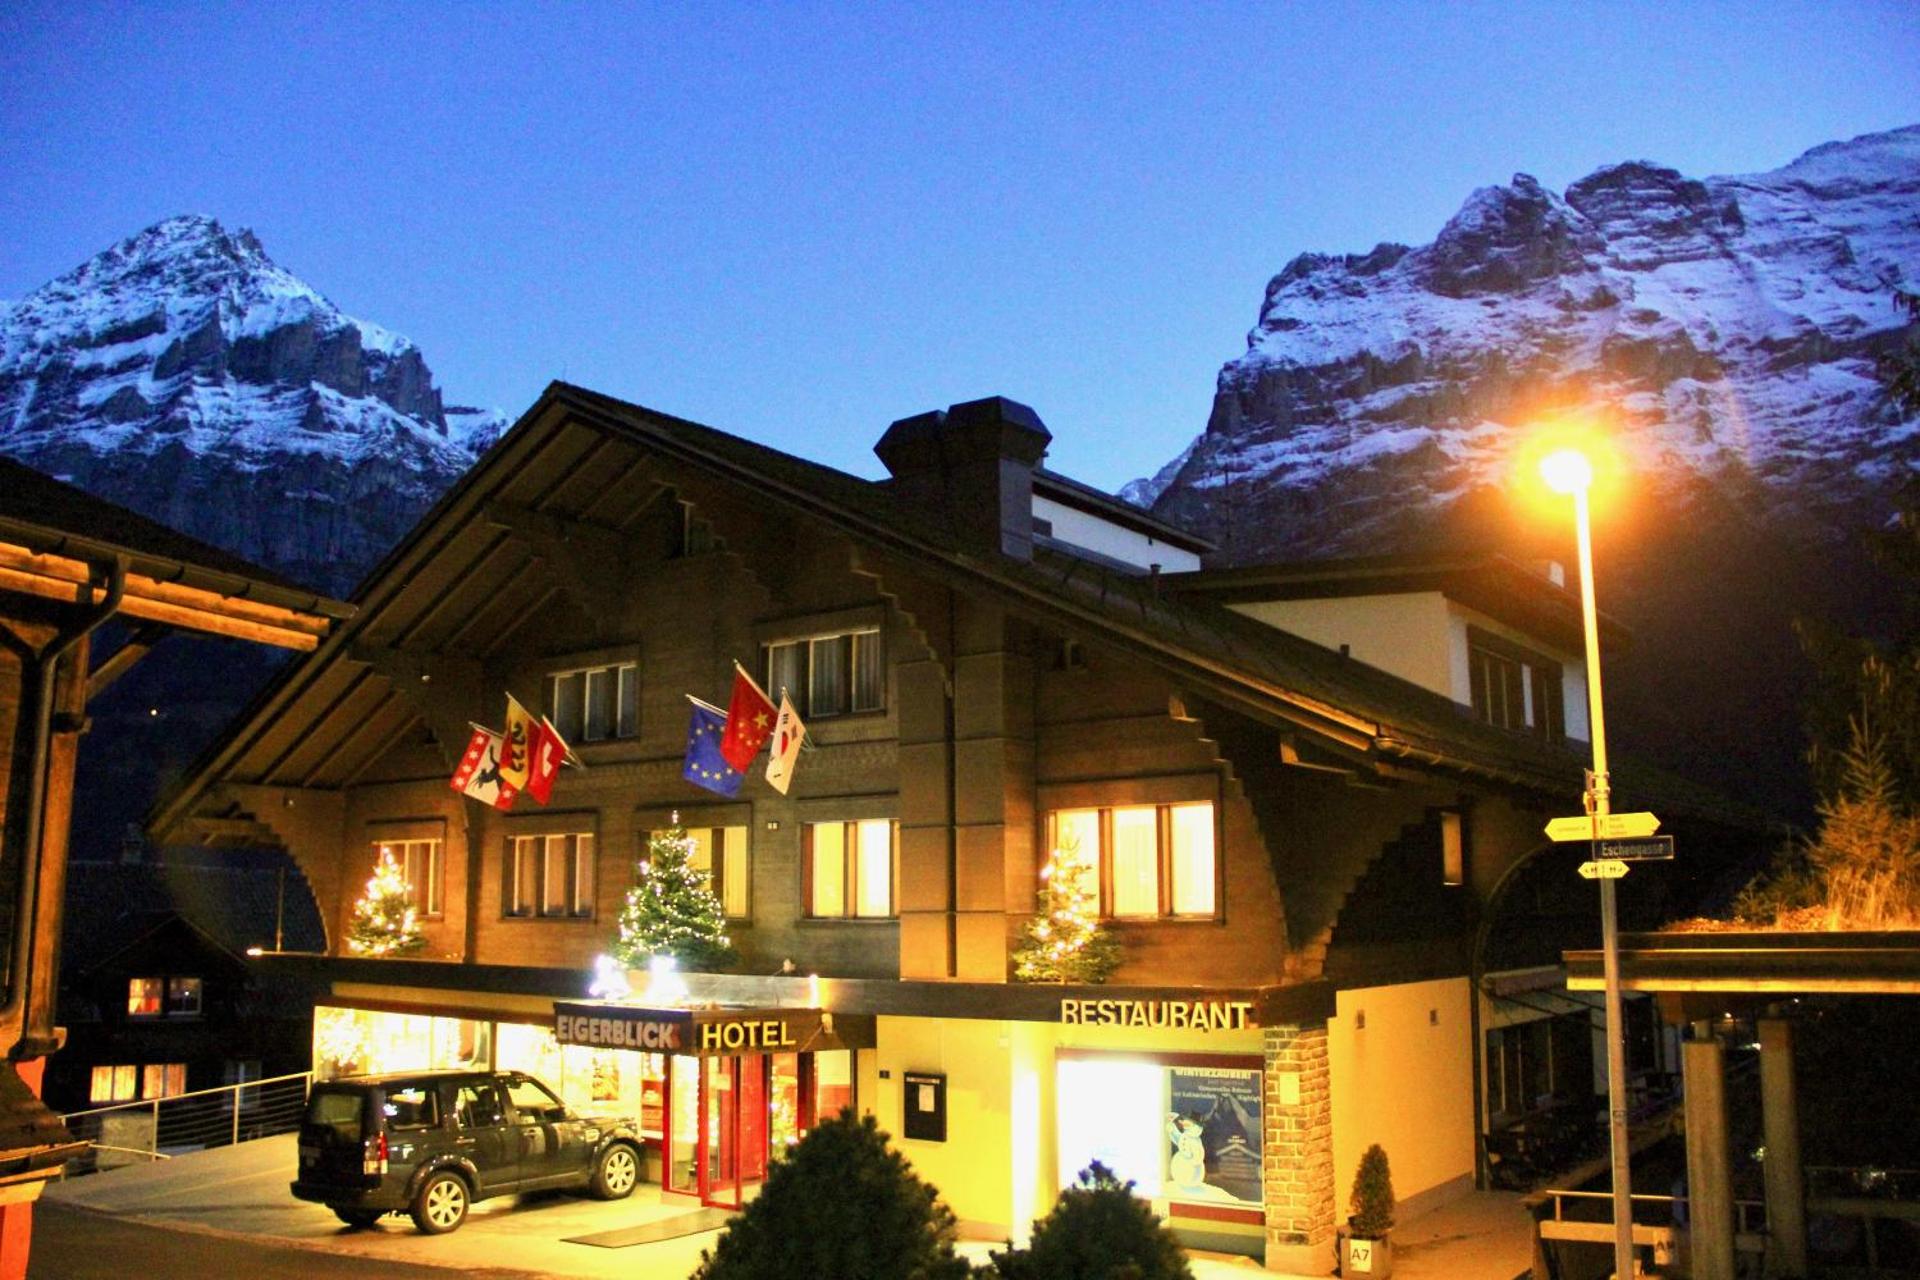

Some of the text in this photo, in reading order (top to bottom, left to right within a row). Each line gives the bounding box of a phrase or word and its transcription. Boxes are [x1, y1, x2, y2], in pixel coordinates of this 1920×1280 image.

[1060, 998, 1252, 1030] RESTAURANT
[557, 1014, 674, 1049] EIGERBLICK
[702, 1020, 797, 1049] HOTEL
[1351, 1247, 1369, 1261] A7
